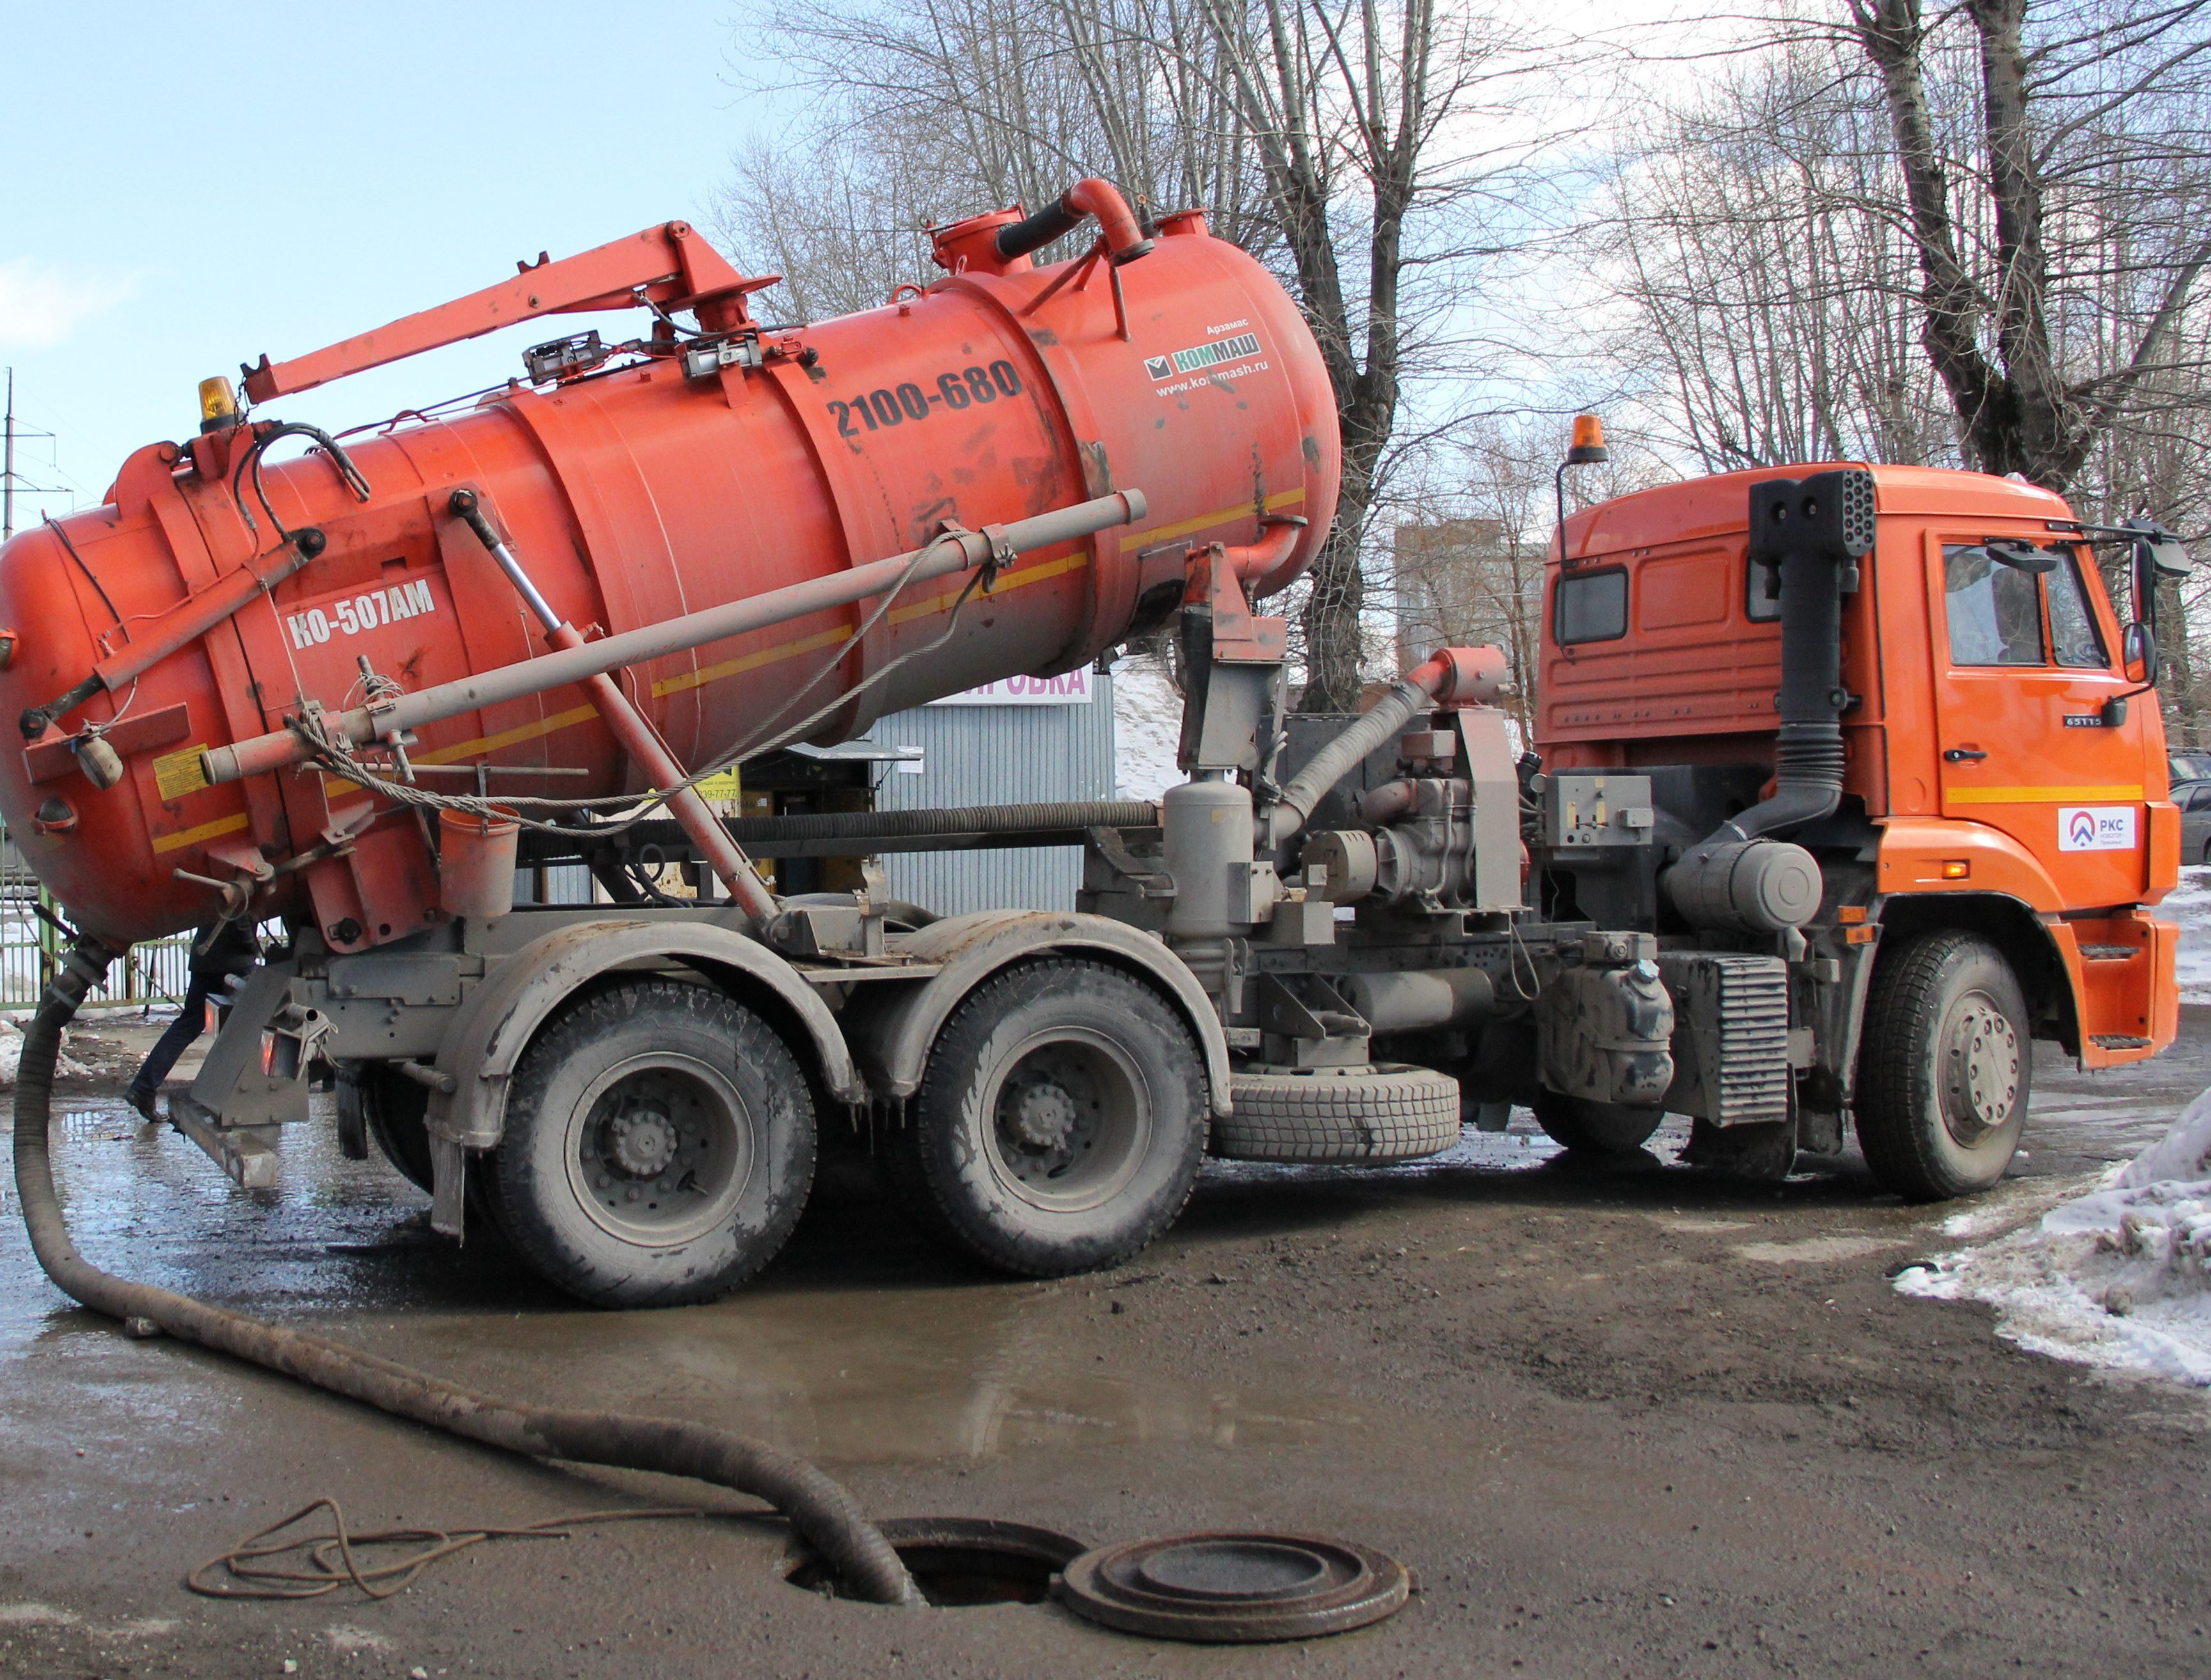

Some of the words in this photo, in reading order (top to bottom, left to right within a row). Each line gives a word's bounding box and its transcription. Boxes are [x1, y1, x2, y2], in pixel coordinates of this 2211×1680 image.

[1206, 318, 1249, 335] Арзамас
[1172, 333, 1261, 372] КОММАШ
[826, 360, 1022, 438] 2100-680
[287, 579, 435, 650] КО-507АМ
[2100, 819, 2123, 831] РКС
